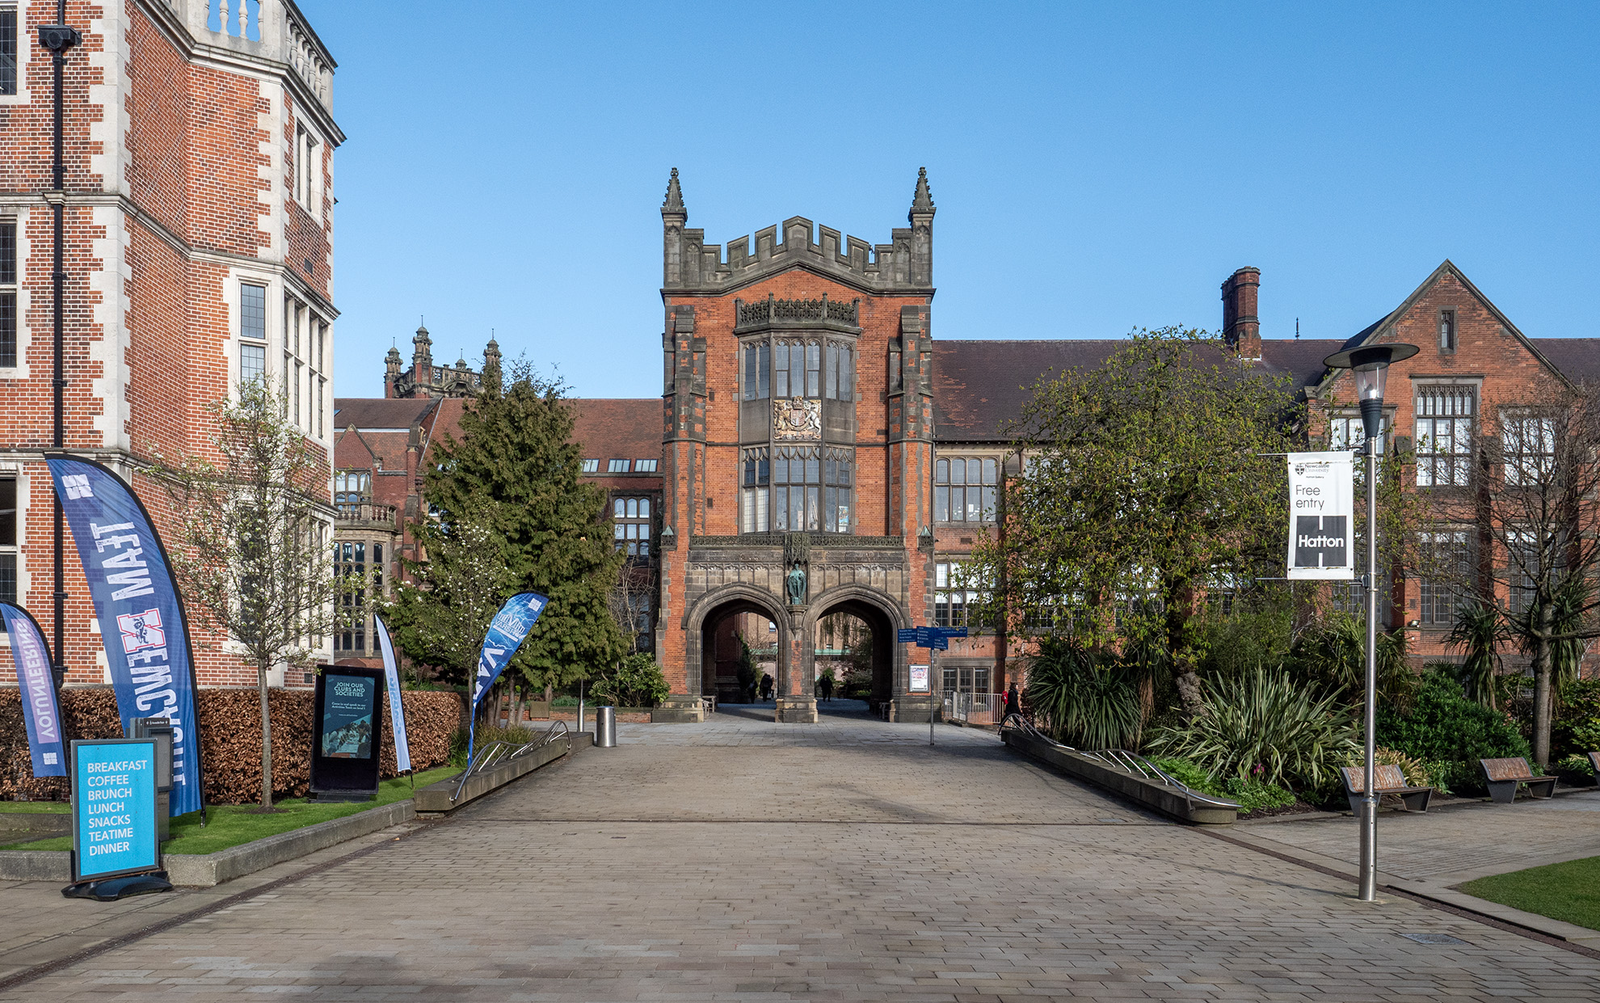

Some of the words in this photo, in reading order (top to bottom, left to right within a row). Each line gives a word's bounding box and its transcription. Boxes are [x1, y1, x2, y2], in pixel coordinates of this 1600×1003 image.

[1295, 484, 1321, 496] Free
[1295, 499, 1325, 510] entry
[1298, 534, 1344, 548] Hatton
[87, 759, 148, 773] BREAKFAST
[87, 774, 130, 787] COFFEE
[88, 787, 132, 801] BRUNCH
[88, 801, 125, 815] LUNCH
[88, 814, 131, 829] SNACKS
[88, 827, 134, 842] TEATIME
[89, 841, 130, 856] DINNER
